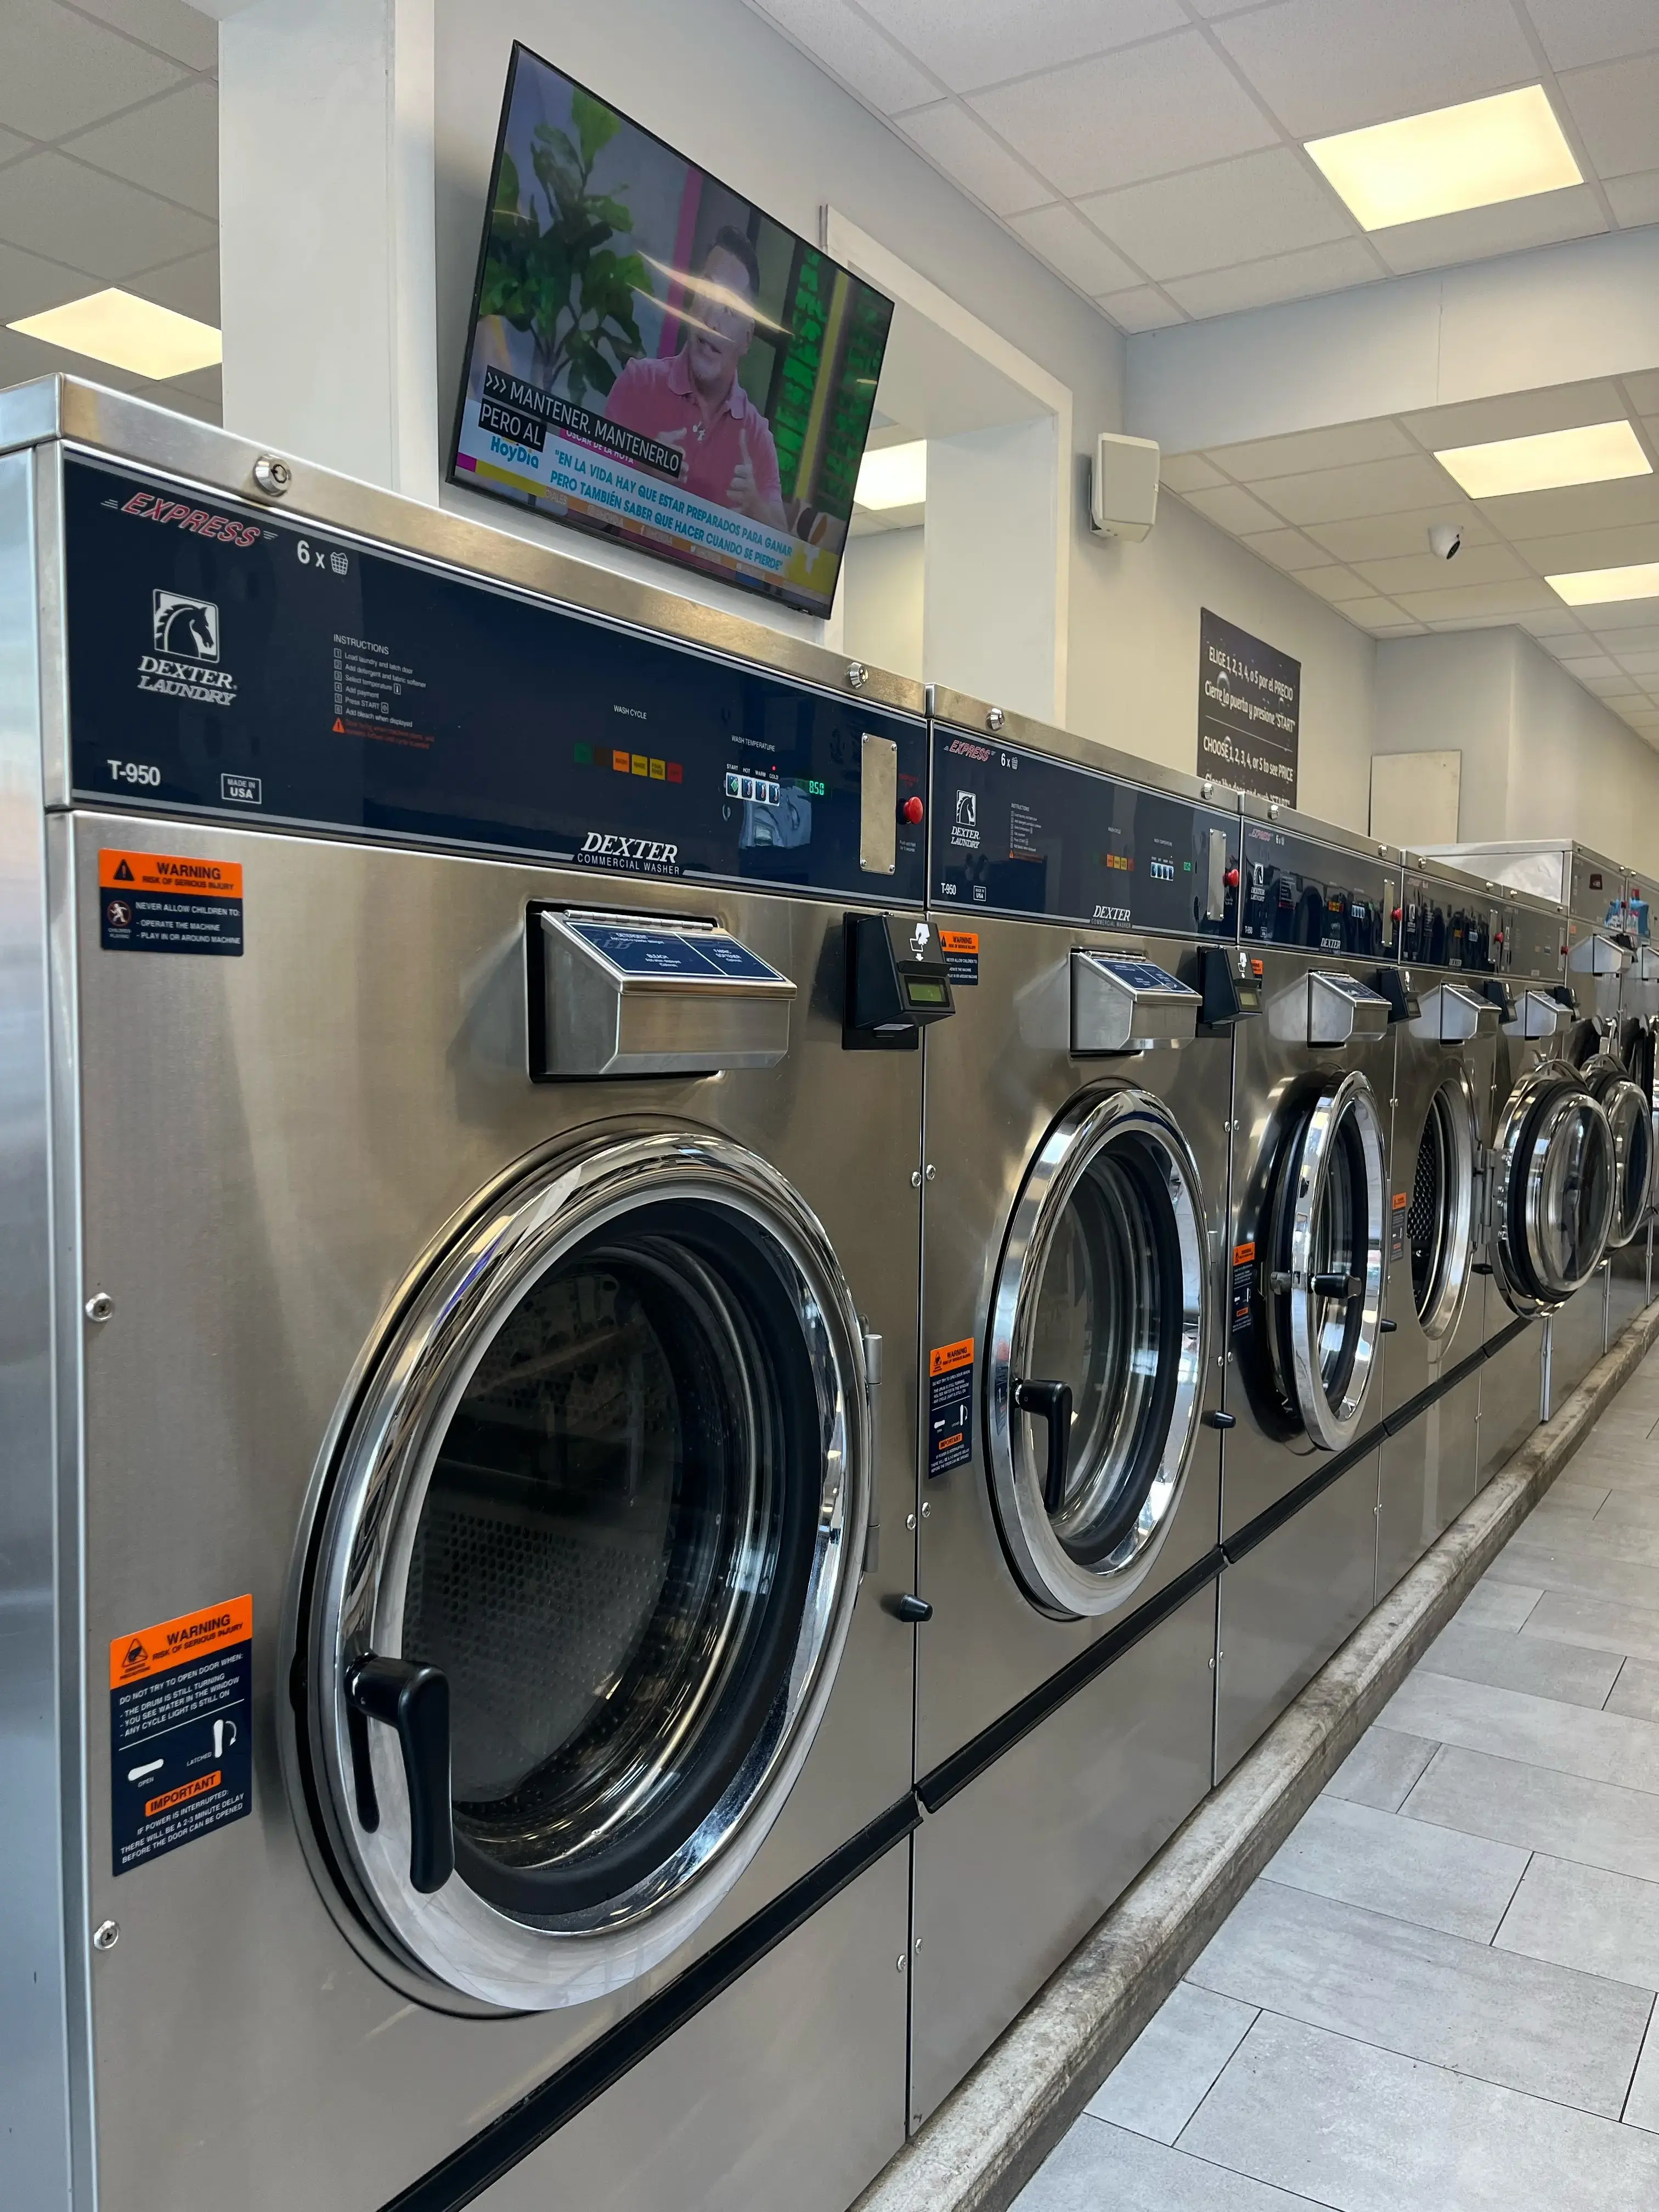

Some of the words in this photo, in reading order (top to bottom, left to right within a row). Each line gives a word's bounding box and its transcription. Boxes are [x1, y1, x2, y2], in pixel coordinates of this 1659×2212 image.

[481, 404, 521, 436] PERO
[523, 423, 541, 445] AL
[510, 382, 590, 434] MANTENER.
[595, 420, 679, 472] MANTENERLO
[121, 492, 260, 546] EXPRESS
[550, 470, 577, 491] PERO
[580, 482, 622, 509] TAMBIÉN
[623, 500, 652, 521] SABER
[654, 512, 673, 529] QUE
[675, 520, 704, 541] HACER
[707, 533, 742, 555] CUANDO
[744, 548, 753, 560] SE
[754, 552, 783, 570] PIERDE"
[574, 458, 586, 474] LA
[590, 464, 613, 485] VIDA
[616, 476, 636, 493] HAY
[638, 485, 657, 502] QUE
[659, 494, 685, 514] ESTAR
[686, 505, 740, 535] PREPARADOS
[742, 528, 762, 545] PARA
[765, 538, 792, 557] GANAR
[297, 540, 309, 564] 6
[334, 634, 389, 655] INSTRUCTIONS
[1209, 646, 1226, 668] ELIGE
[1227, 656, 1231, 674] 1,
[1232, 659, 1237, 676] 2,
[1238, 662, 1243, 680] 3,
[1244, 665, 1249, 682] 4,
[1254, 670, 1258, 684] 5
[1259, 675, 1268, 690] por
[1268, 678, 1273, 692] el
[1274, 680, 1293, 701] PRECIO
[137, 676, 237, 706] LAUNDRY
[1205, 680, 1222, 702] Cierre
[1223, 688, 1229, 704] la
[1230, 695, 1248, 710] puerta
[1249, 703, 1253, 720] y
[1254, 706, 1274, 725] presione
[613, 705, 629, 715] WASH
[630, 709, 647, 719] CYCLE
[731, 735, 744, 744] WASH
[744, 738, 775, 752] TEMPERATURE
[949, 740, 990, 762] EXPRESS
[1001, 753, 1006, 766] 6
[1203, 736, 1229, 758] CHOOSE
[1229, 746, 1234, 763] 1,
[1235, 748, 1240, 765] 2,
[1241, 751, 1246, 768] 3,
[1247, 753, 1252, 770] 4,
[1252, 757, 1259, 769] or
[1259, 757, 1262, 771] 5
[1263, 758, 1269, 773] to
[1269, 764, 1278, 776] see
[1278, 764, 1293, 782] PRICE
[108, 759, 161, 786] T-950
[227, 778, 247, 788] MADE
[230, 787, 253, 799] USA
[580, 832, 678, 864] DEXTER
[951, 837, 980, 849] LAUNDRY
[156, 862, 221, 879] WARNING
[577, 853, 640, 870] COMMERCIAL
[644, 862, 679, 875] WASHER
[941, 883, 956, 895] T-950
[136, 902, 162, 911] NEVER
[191, 906, 228, 915] CHILDREN
[1093, 905, 1131, 922] DEXTER
[140, 919, 174, 928] OPERATE
[190, 923, 220, 931] MACHINE
[1091, 918, 1115, 927] COMMERCIAL
[181, 934, 210, 943] AROUND
[1321, 938, 1341, 949] DEXTER
[947, 1346, 967, 1358] WARNING
[153, 1649, 169, 1660] RISK
[172, 1645, 182, 1653] OF
[184, 1632, 216, 1649] SERIOUS
[218, 1622, 243, 1637] INJURY
[167, 1614, 230, 1646] WARNING
[120, 1696, 131, 1705] DO
[133, 1689, 148, 1700] NOT
[150, 1682, 165, 1693] TRY
[166, 1678, 176, 1686] TO
[178, 1670, 198, 1683] OPEN
[199, 1662, 219, 1674] DOOR
[221, 1654, 244, 1665] WHEN:
[125, 1706, 139, 1717] THE
[141, 1697, 163, 1710] DRUM
[173, 1685, 193, 1698] STILL
[194, 1673, 225, 1690] TURNING
[125, 1716, 140, 1726] YOU
[143, 1709, 157, 1720] SEE
[159, 1698, 184, 1712] WATER
[195, 1688, 208, 1698] THE
[211, 1676, 240, 1692] WINDOW
[125, 1726, 140, 1737] ANY
[142, 1715, 166, 1729] CYCLE
[168, 1706, 189, 1719] LIGHT
[199, 1695, 218, 1706] STILL
[220, 1689, 230, 1697] ON
[187, 1752, 212, 1767] LATCHED
[138, 1777, 154, 1787] OPEN
[151, 1775, 216, 1812] IMPORTANT
[121, 1838, 145, 1854] THERE
[147, 1831, 164, 1842] WILL
[165, 1824, 175, 1833] BE
[183, 1817, 194, 1826] 2-3
[195, 1804, 221, 1820] MINUTE
[222, 1793, 244, 1808] DELAY
[146, 1814, 171, 1832] POWER
[181, 1790, 229, 1815] INTERRUPTED:
[122, 1846, 151, 1864] BEFORE
[153, 1838, 166, 1848] THE
[168, 1829, 188, 1842] DOOR
[189, 1822, 204, 1832] CAN
[205, 1816, 215, 1824] BE
[216, 1803, 242, 1820] OPENED
